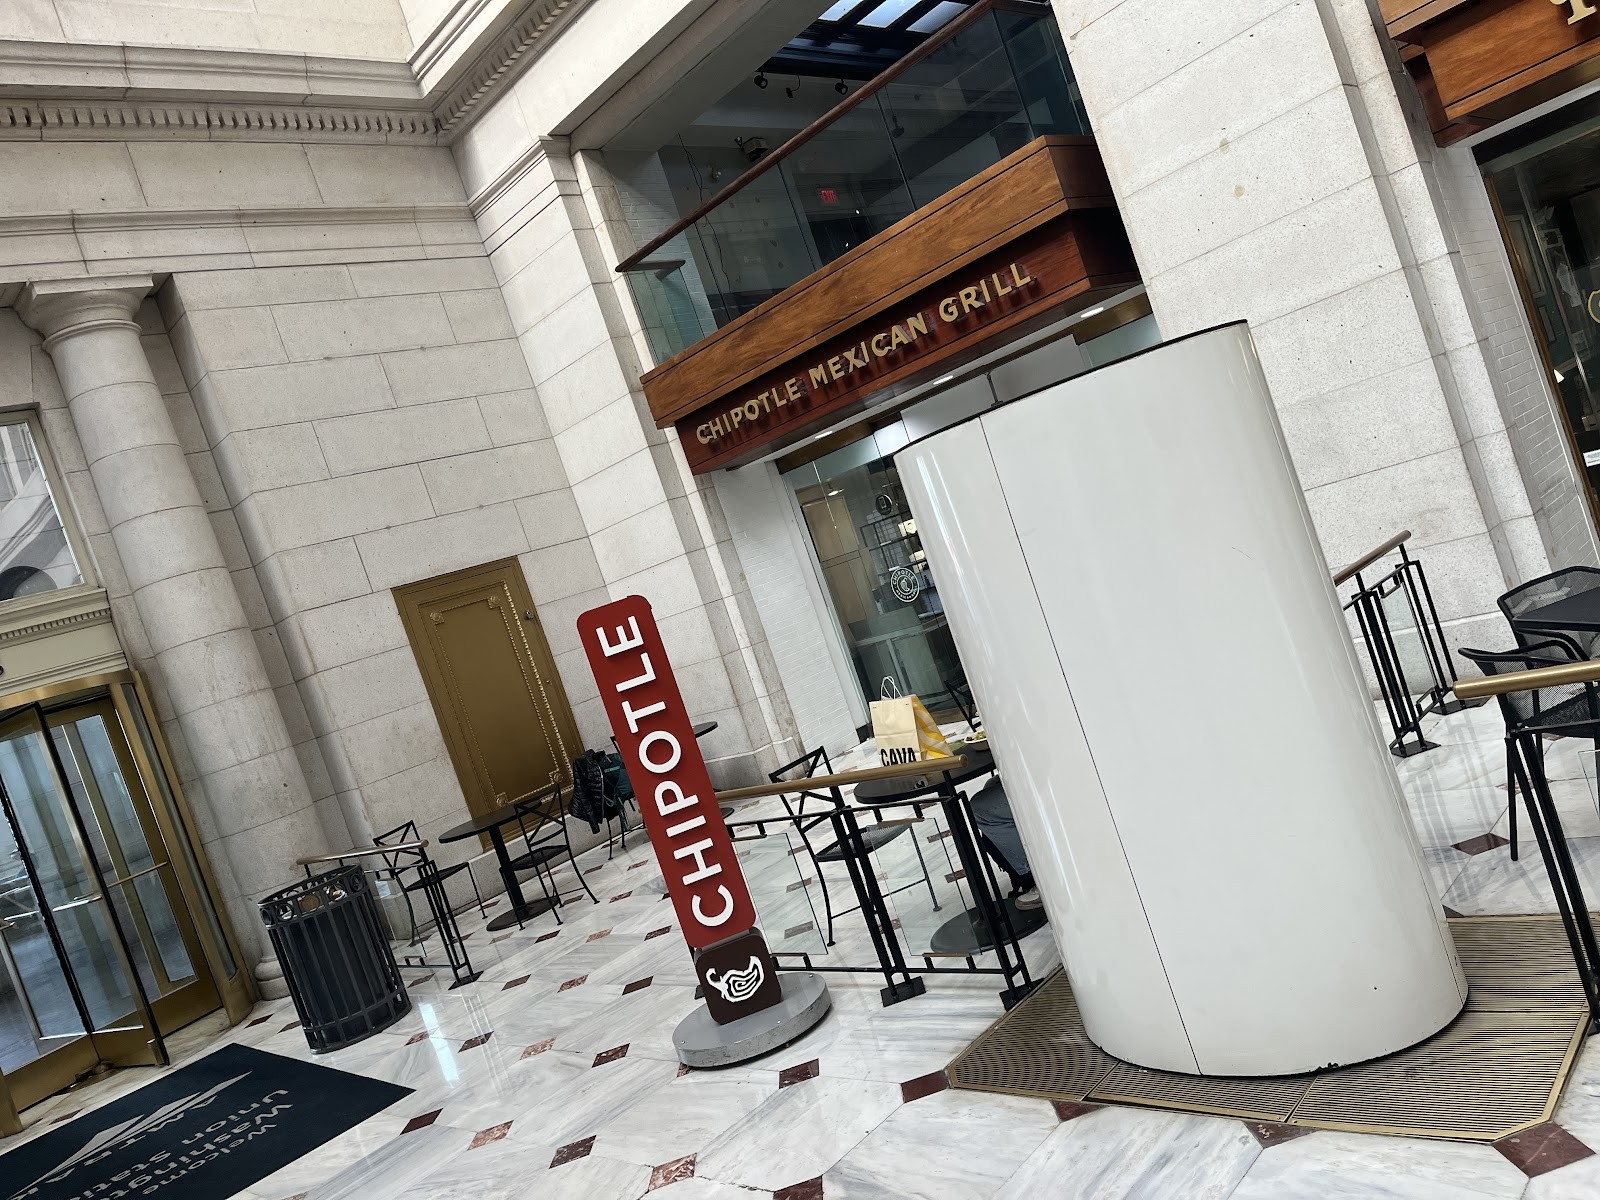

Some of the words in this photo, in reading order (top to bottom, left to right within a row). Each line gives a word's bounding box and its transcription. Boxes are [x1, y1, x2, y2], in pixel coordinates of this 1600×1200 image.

[696, 377, 802, 445] CHIPOTLE
[808, 312, 928, 390] MEXICAN
[938, 262, 1034, 323] GRILL
[596, 615, 734, 927] CHIPOTLE
[880, 747, 917, 767] CAVA
[181, 1089, 289, 1145] Union
[69, 1150, 171, 1200] Stati
[142, 1124, 277, 1195] Welcome
